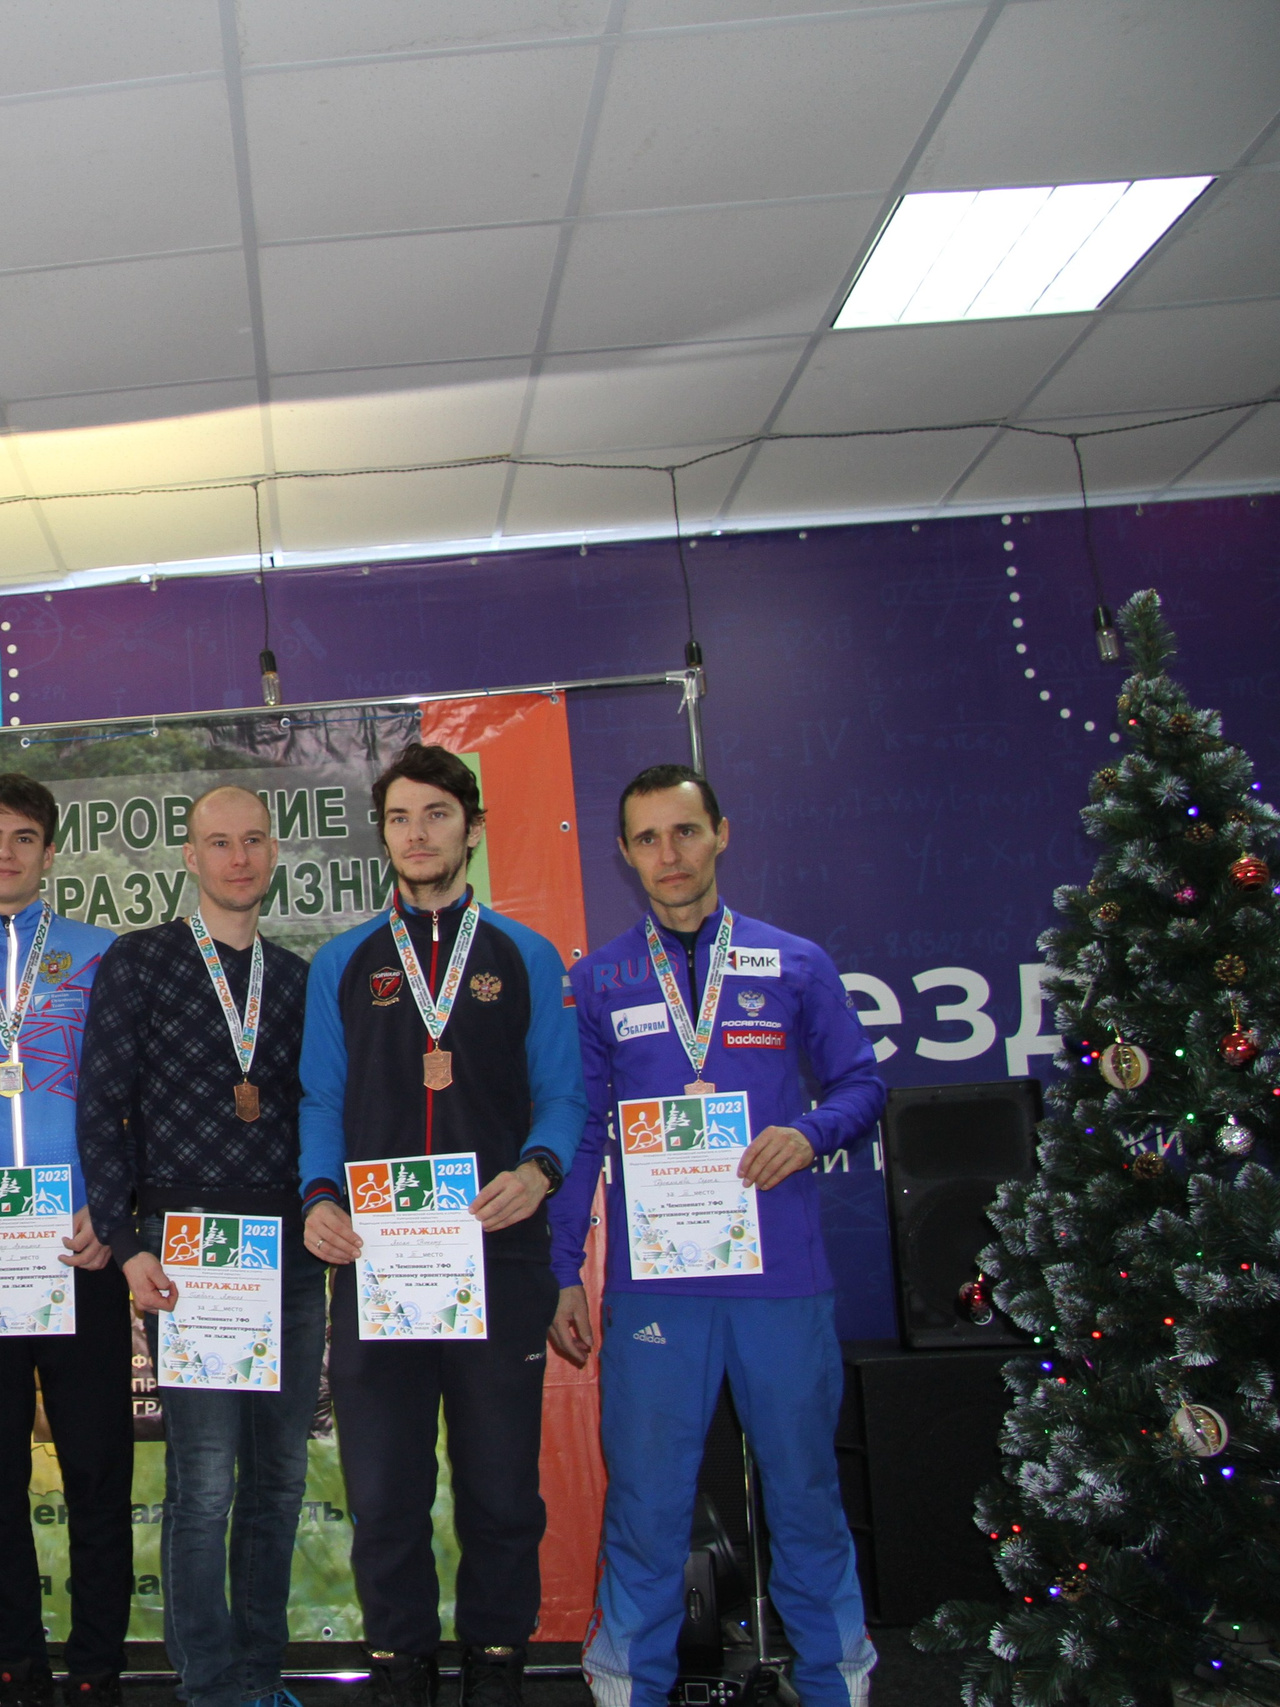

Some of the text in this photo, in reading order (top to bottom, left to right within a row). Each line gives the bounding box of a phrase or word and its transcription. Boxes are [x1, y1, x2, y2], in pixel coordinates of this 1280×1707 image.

[191, 914, 206, 939] 2023
[461, 910, 476, 938] 2023
[33, 924, 47, 952] 2023
[718, 925, 730, 953] 2023
[630, 1020, 666, 1035] GAZPROM
[721, 1020, 782, 1029] РОСАВТОДОР
[727, 1033, 783, 1046] backaldrin
[708, 1098, 742, 1109] 2023
[38, 1170, 69, 1182] 2023
[438, 1163, 472, 1176] 2023
[650, 1164, 732, 1176] НАГРАЖДАЕТ
[245, 1224, 276, 1237] 2023
[381, 1227, 460, 1236] НАГРАЖДАЕТ
[185, 1281, 260, 1292] НАГРАЖДАЕТ
[632, 1332, 667, 1345] adidas
